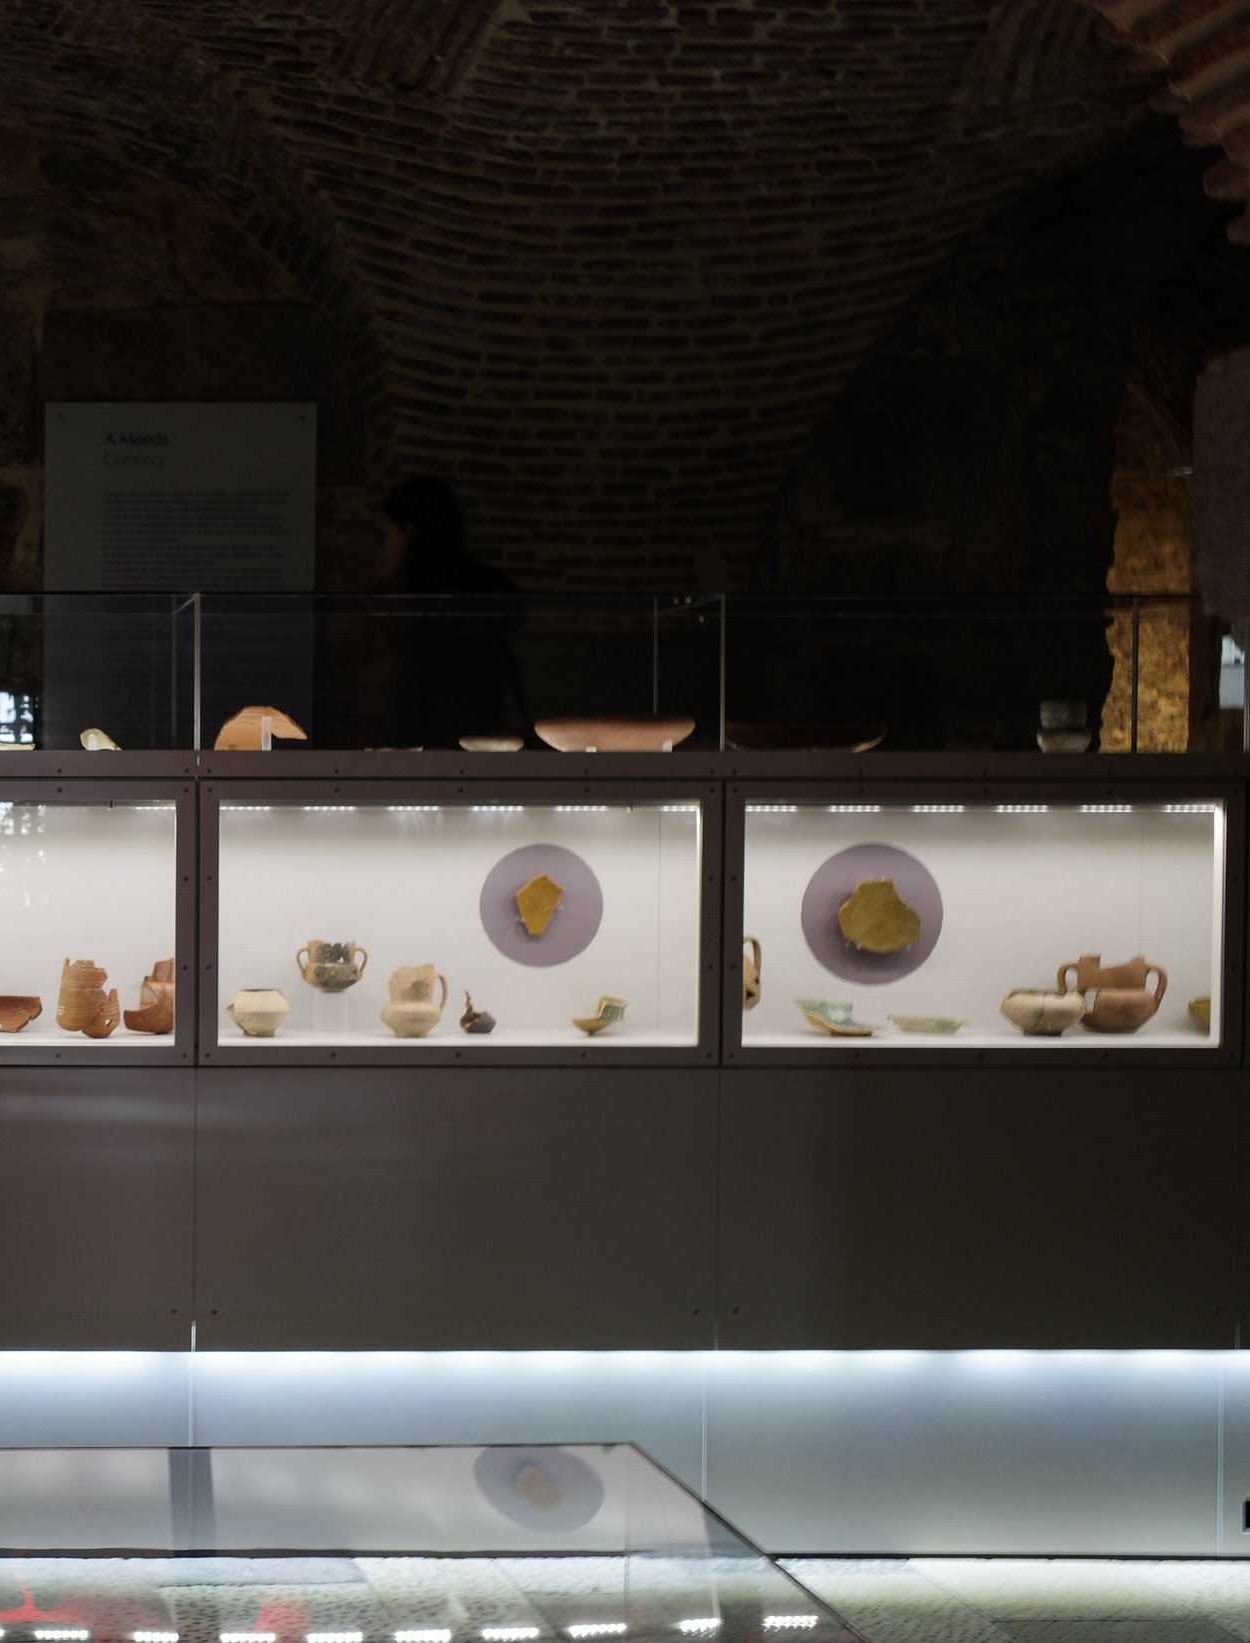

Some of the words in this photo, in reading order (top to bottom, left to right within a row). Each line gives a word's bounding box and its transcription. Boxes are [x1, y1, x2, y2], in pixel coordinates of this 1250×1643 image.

[103, 432, 116, 446] A
[119, 430, 170, 447] Moeda
[103, 450, 167, 471] Currency
